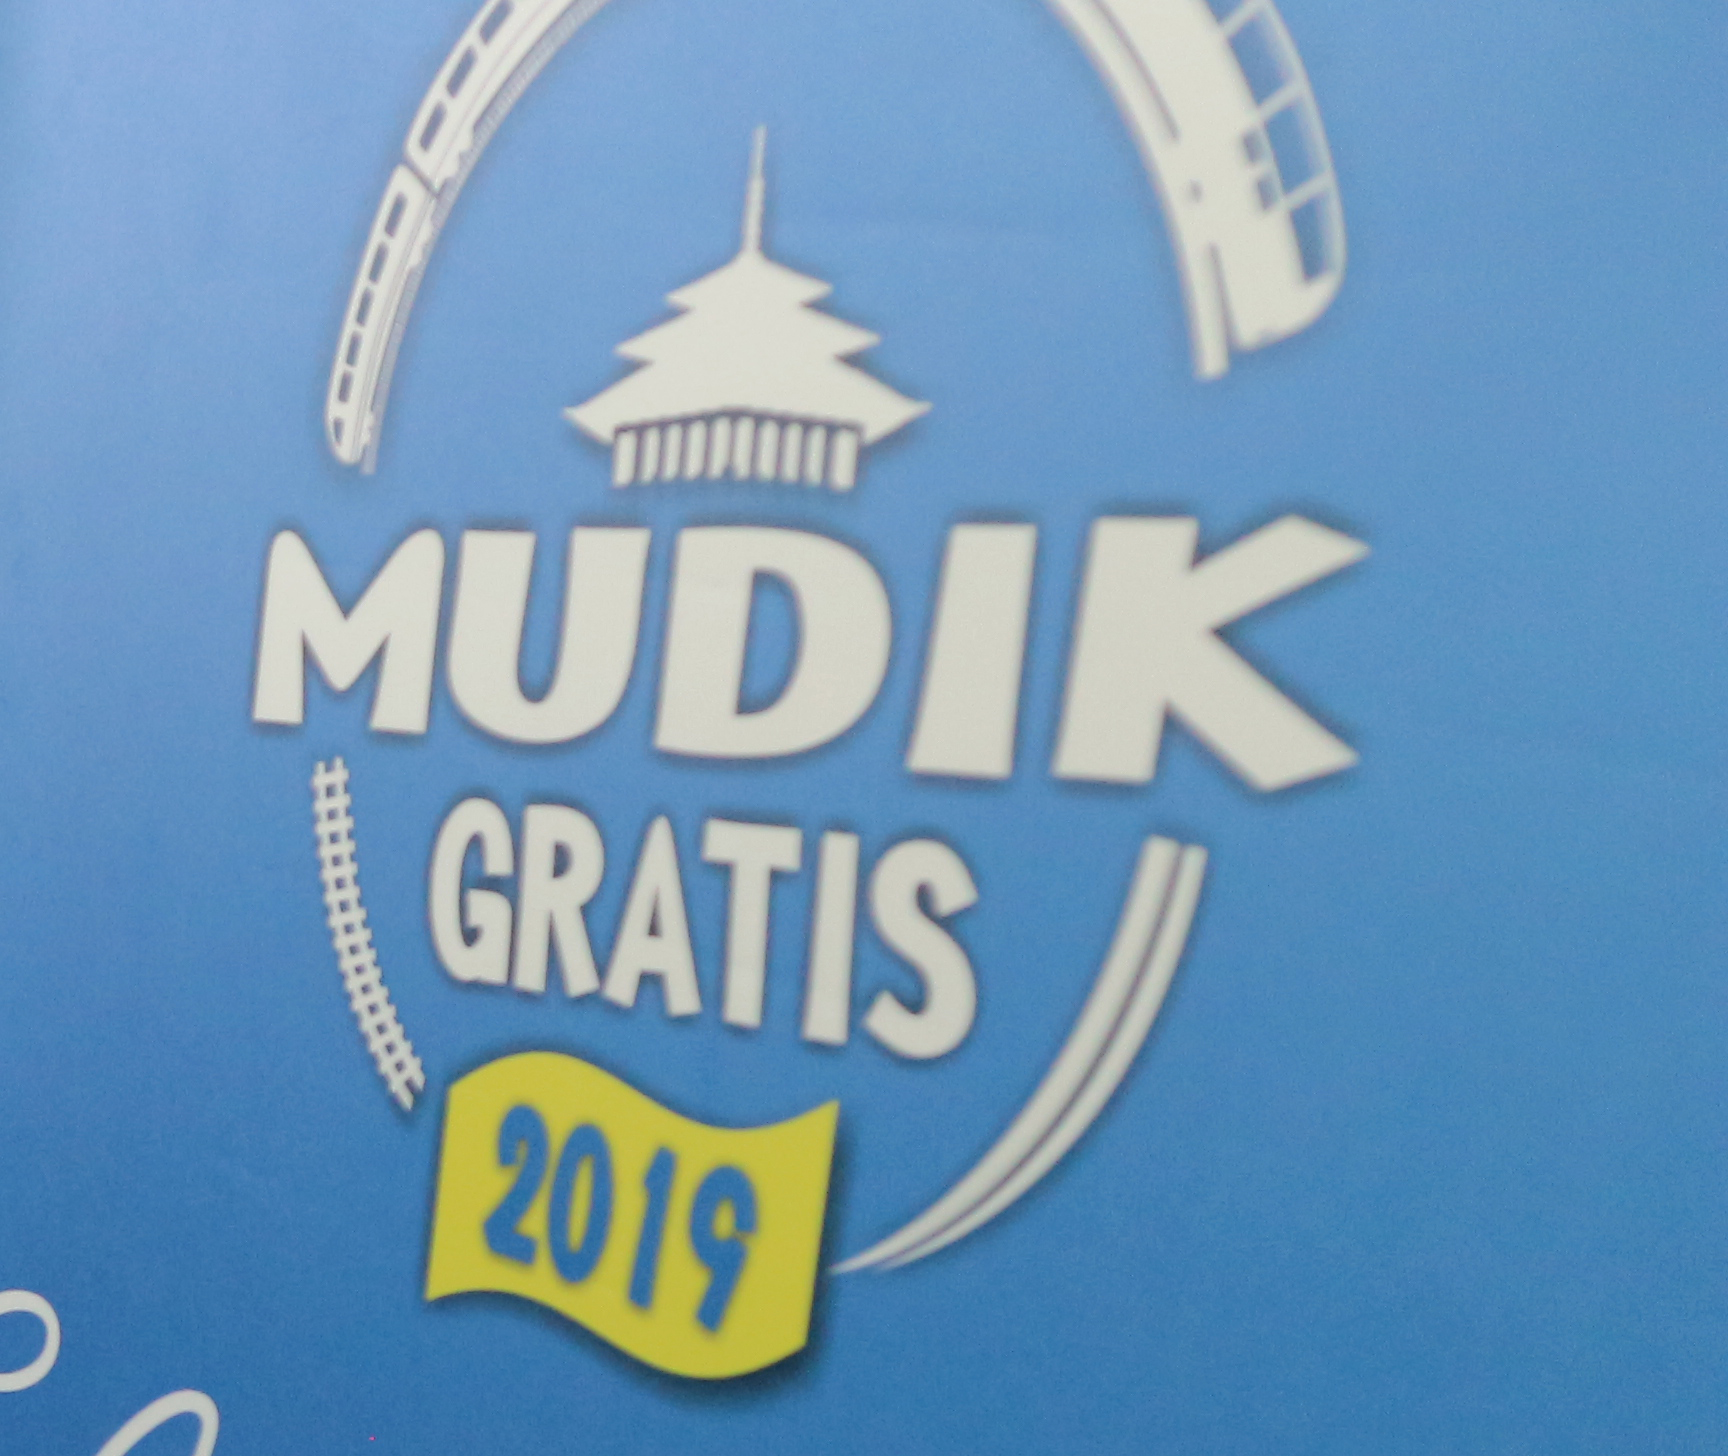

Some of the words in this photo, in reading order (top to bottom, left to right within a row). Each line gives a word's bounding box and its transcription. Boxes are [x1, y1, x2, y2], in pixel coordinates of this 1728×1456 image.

[251, 513, 1372, 794] MUDIK
[427, 796, 981, 1062] GRATIS
[481, 1101, 761, 1335] 2019
